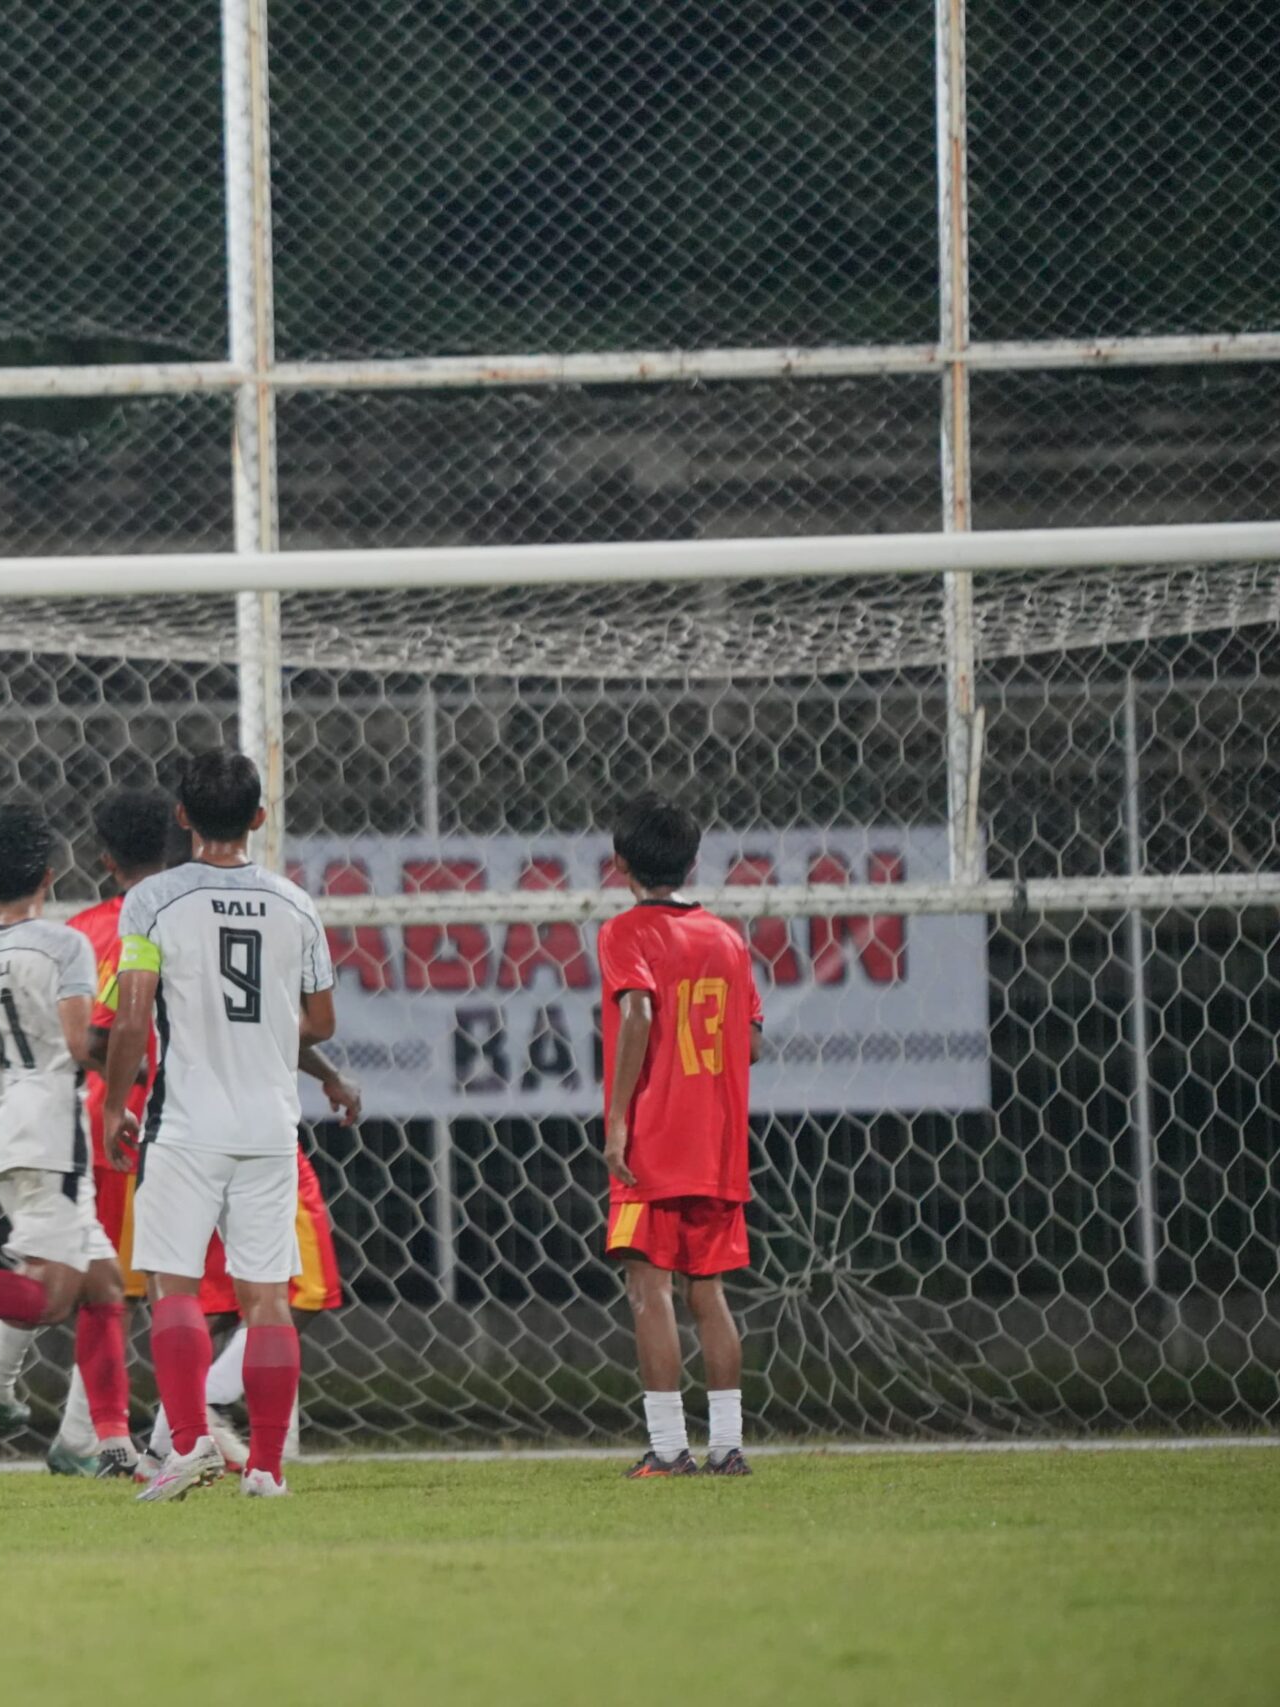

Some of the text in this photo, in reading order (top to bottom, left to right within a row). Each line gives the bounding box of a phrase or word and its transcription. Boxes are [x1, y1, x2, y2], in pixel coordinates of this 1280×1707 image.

[211, 899, 267, 917] BALI
[284, 855, 909, 991] ABAAN
[219, 926, 263, 1023] 9
[453, 1003, 604, 1092] BA
[676, 977, 729, 1077] 13
